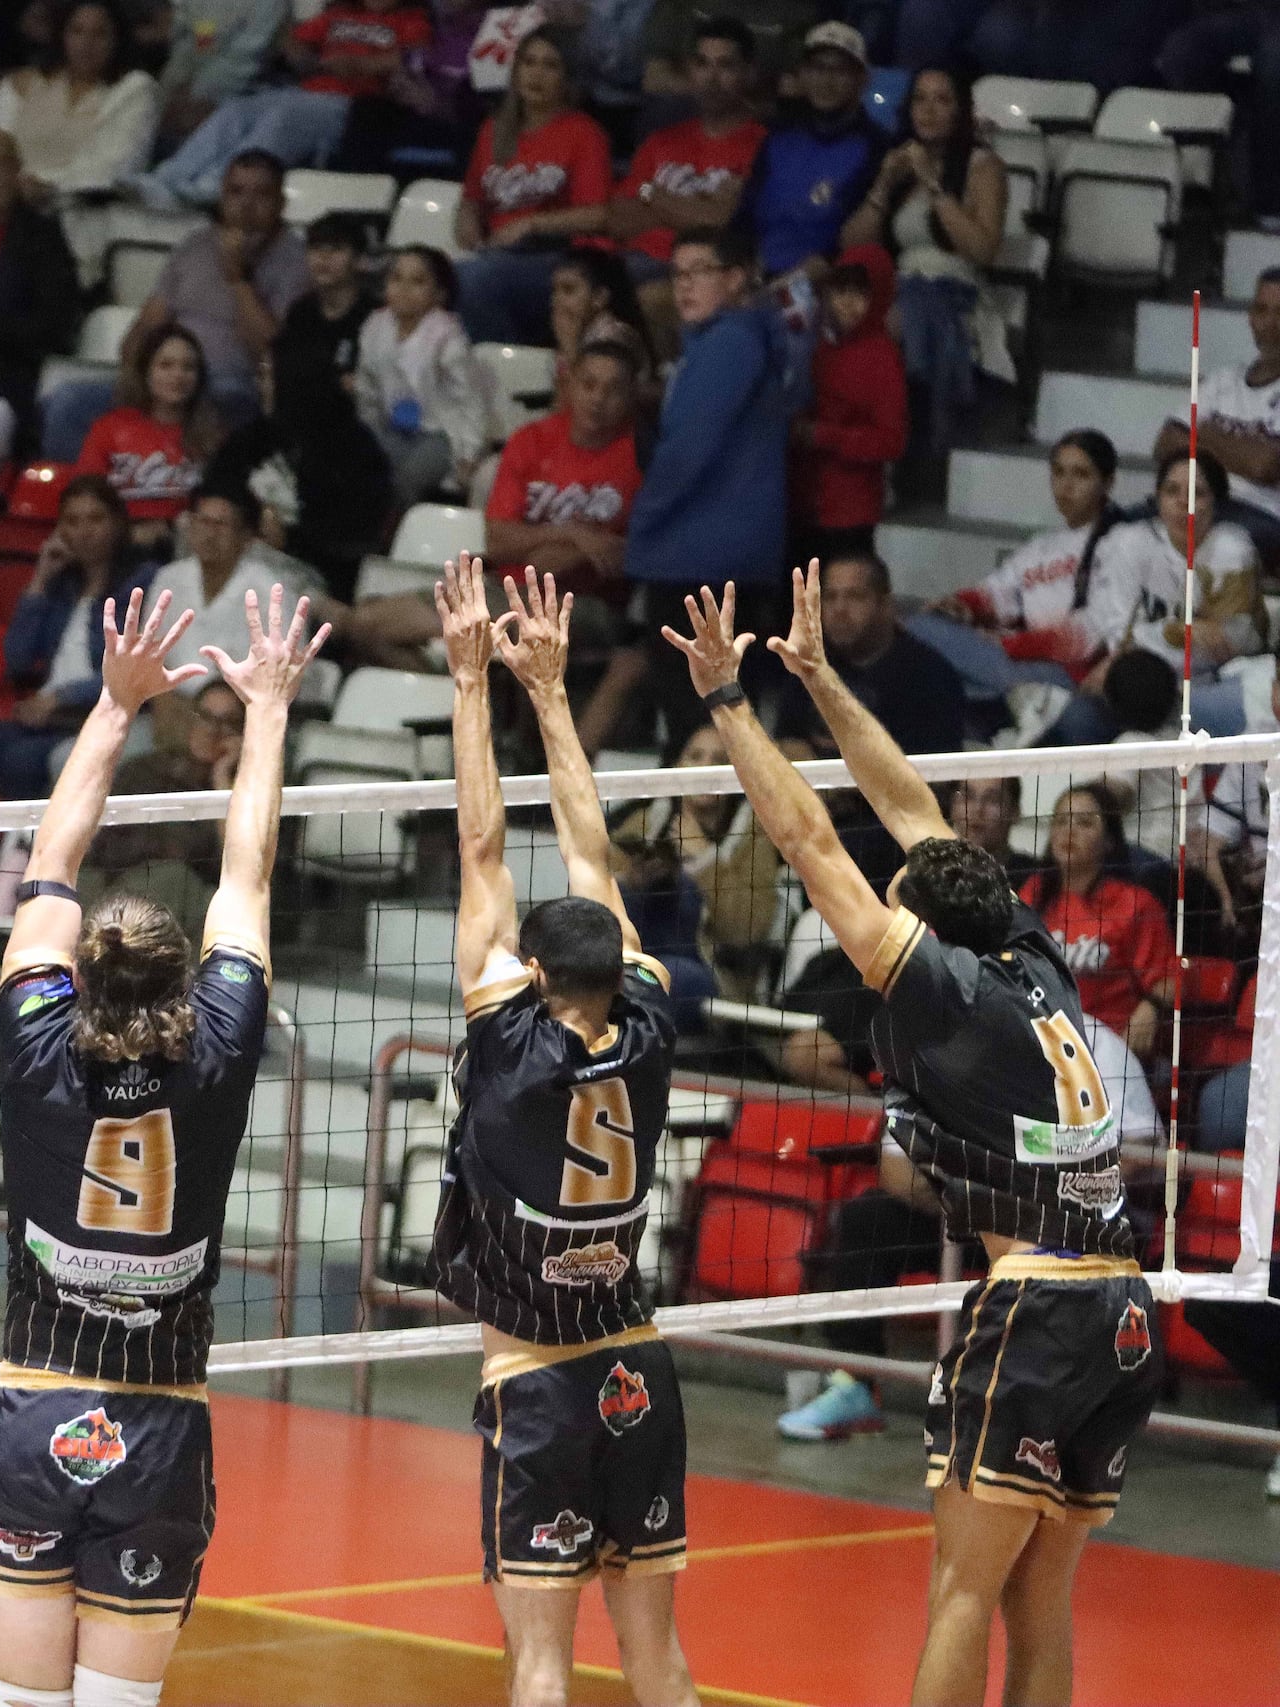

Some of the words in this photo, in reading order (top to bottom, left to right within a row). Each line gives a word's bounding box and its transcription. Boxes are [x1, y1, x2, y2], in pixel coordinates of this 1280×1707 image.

[104, 1078, 161, 1101] YAUCO
[76, 1107, 177, 1236] 9
[56, 1247, 202, 1277] LABORATORIO
